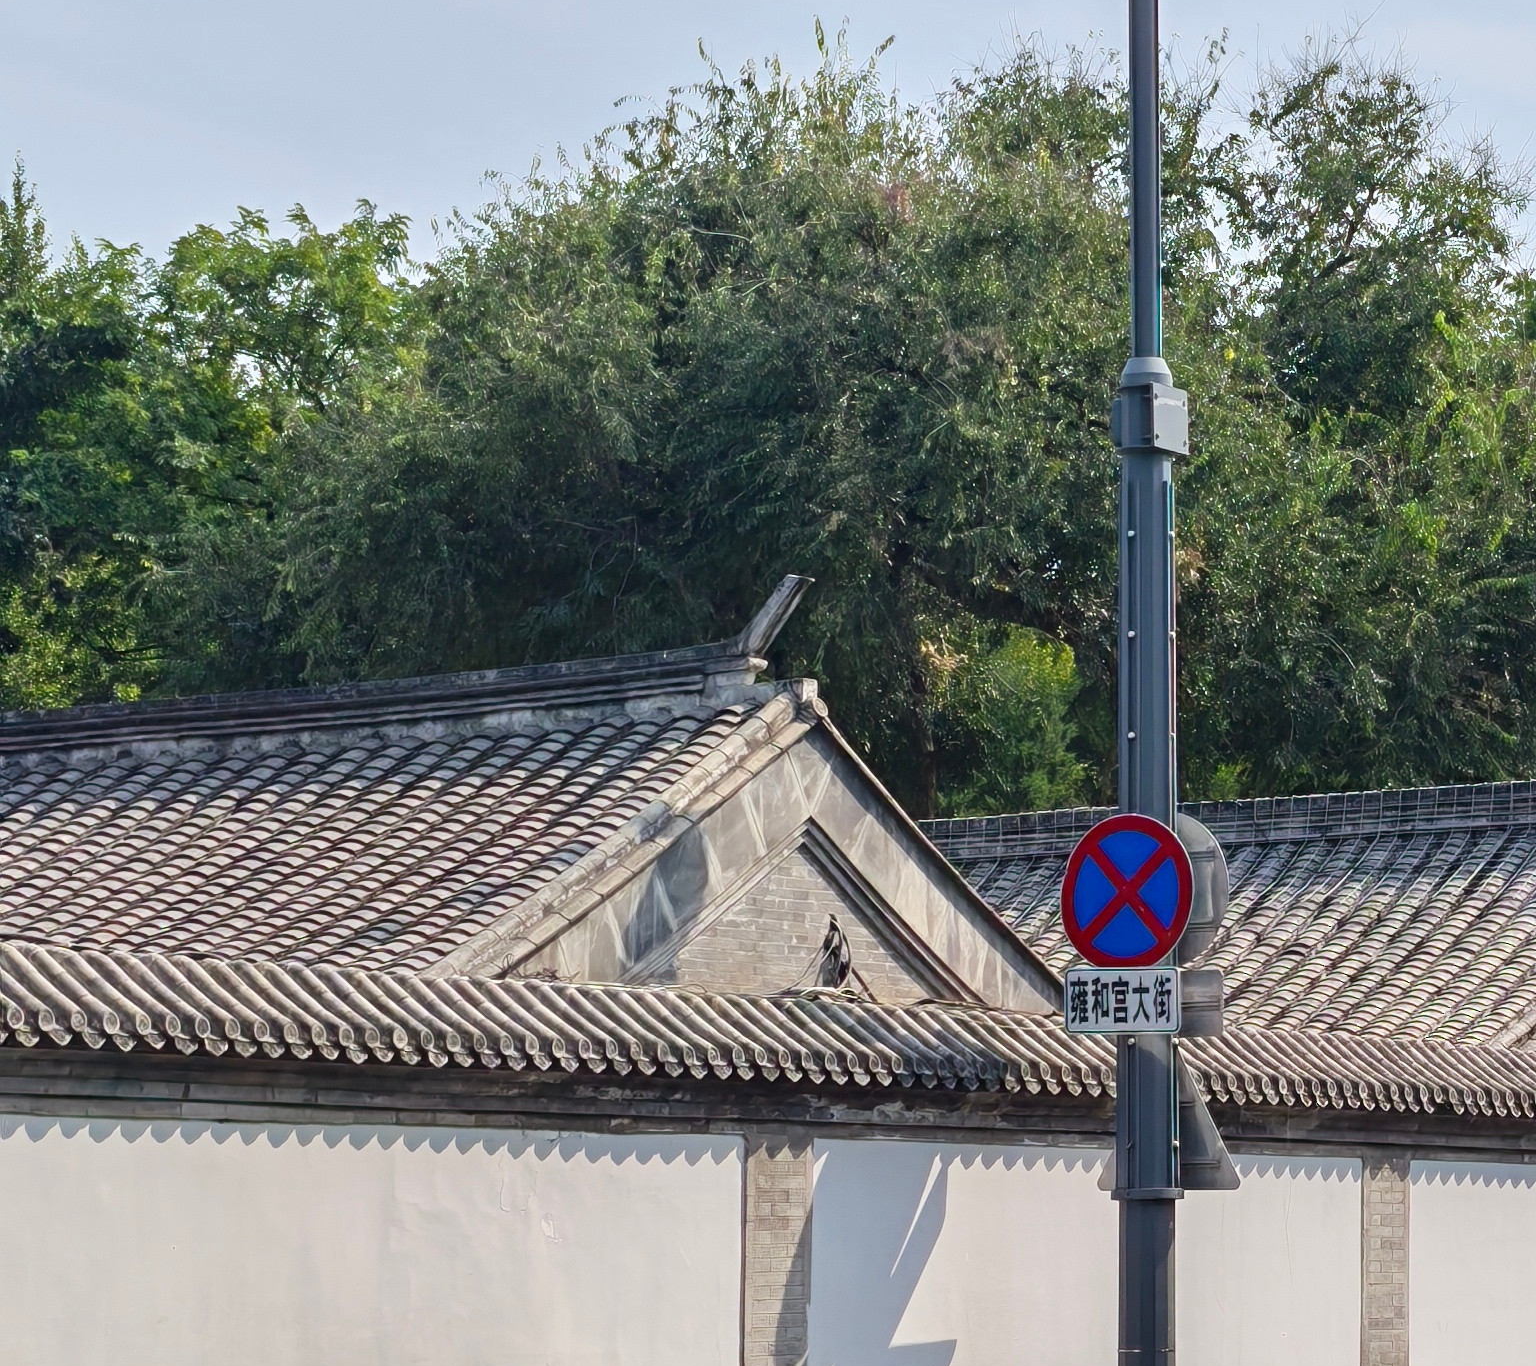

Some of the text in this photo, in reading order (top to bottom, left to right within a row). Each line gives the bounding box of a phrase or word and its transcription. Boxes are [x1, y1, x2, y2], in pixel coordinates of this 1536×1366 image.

[1069, 974, 1172, 1024] 雍和宫大街
